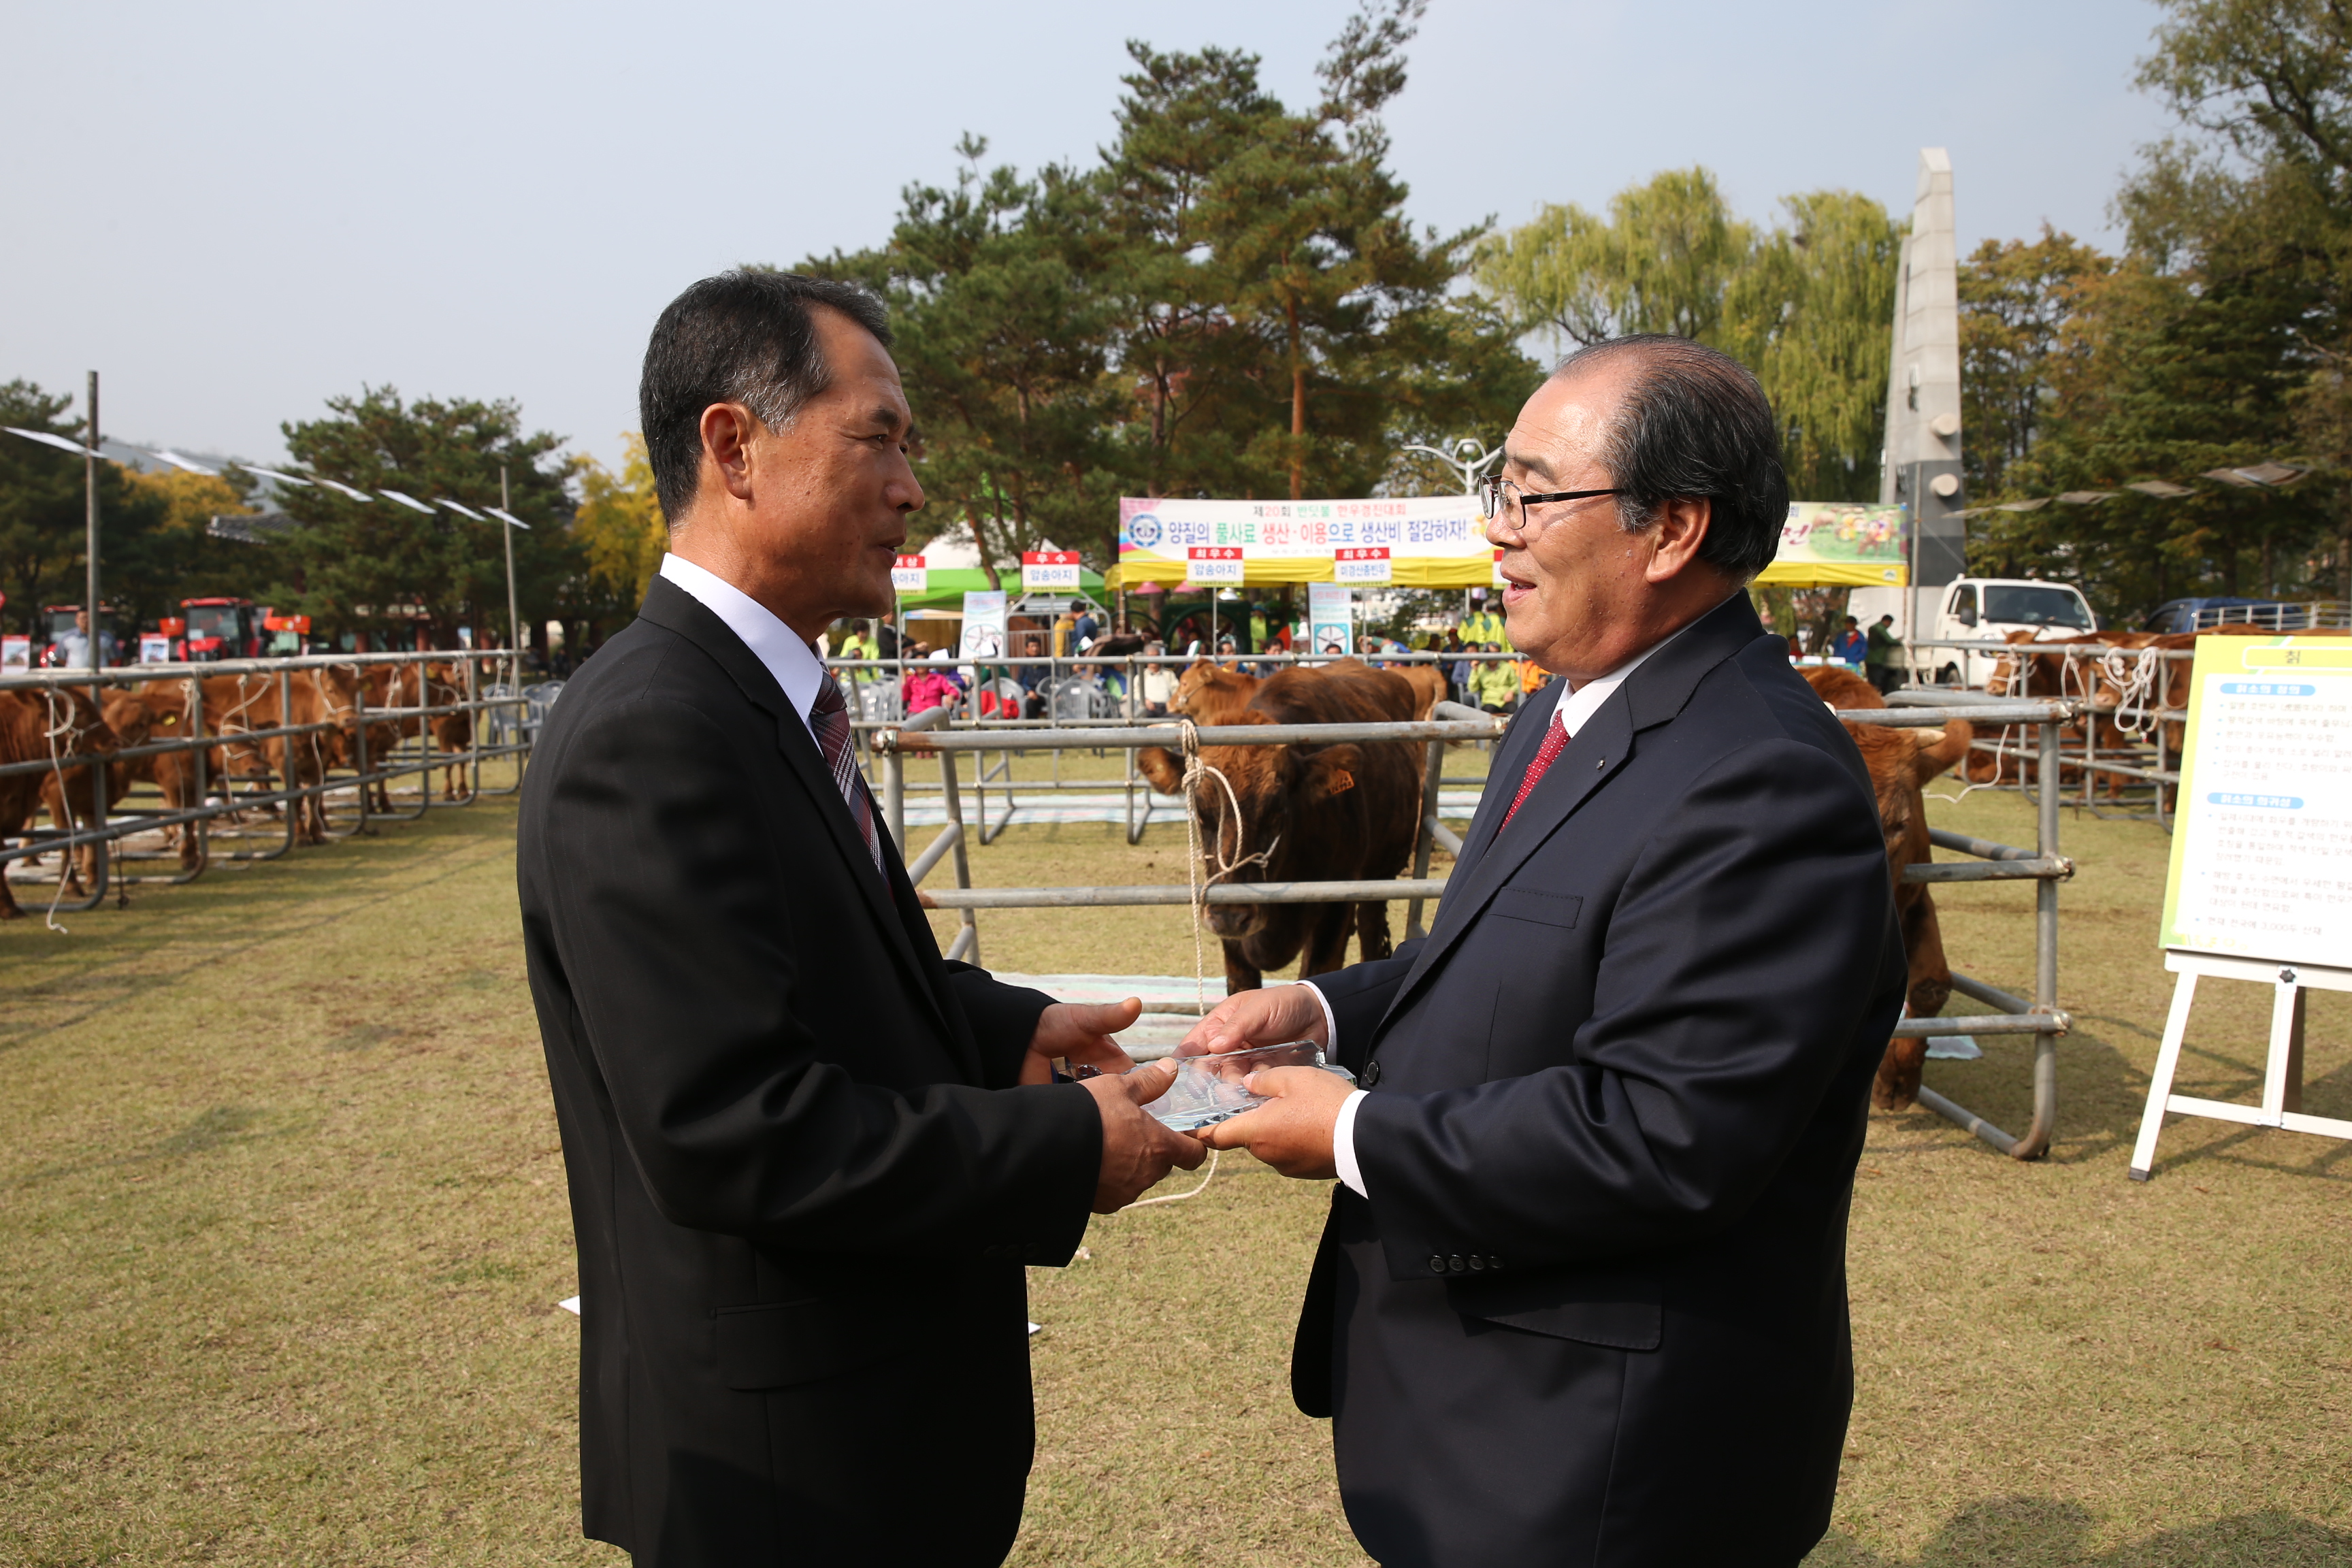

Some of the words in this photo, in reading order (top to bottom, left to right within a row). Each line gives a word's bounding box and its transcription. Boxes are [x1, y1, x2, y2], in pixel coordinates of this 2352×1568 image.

[1254, 505, 1291, 517] 제20회
[1296, 504, 1330, 517] 반딧불
[1337, 504, 1407, 518] 한우경진대회
[1169, 521, 1210, 544] 양질의
[1215, 521, 1257, 544] 풀사료
[1360, 521, 1401, 544] 생산비
[1407, 518, 1467, 542] 절감하자!
[1036, 553, 1067, 564] 우수
[1195, 548, 1235, 559] 최우수
[1343, 547, 1383, 559] 최우수
[1030, 569, 1073, 582] 암송아지
[1194, 564, 1237, 577] 암송아지
[892, 572, 919, 584] 송아지
